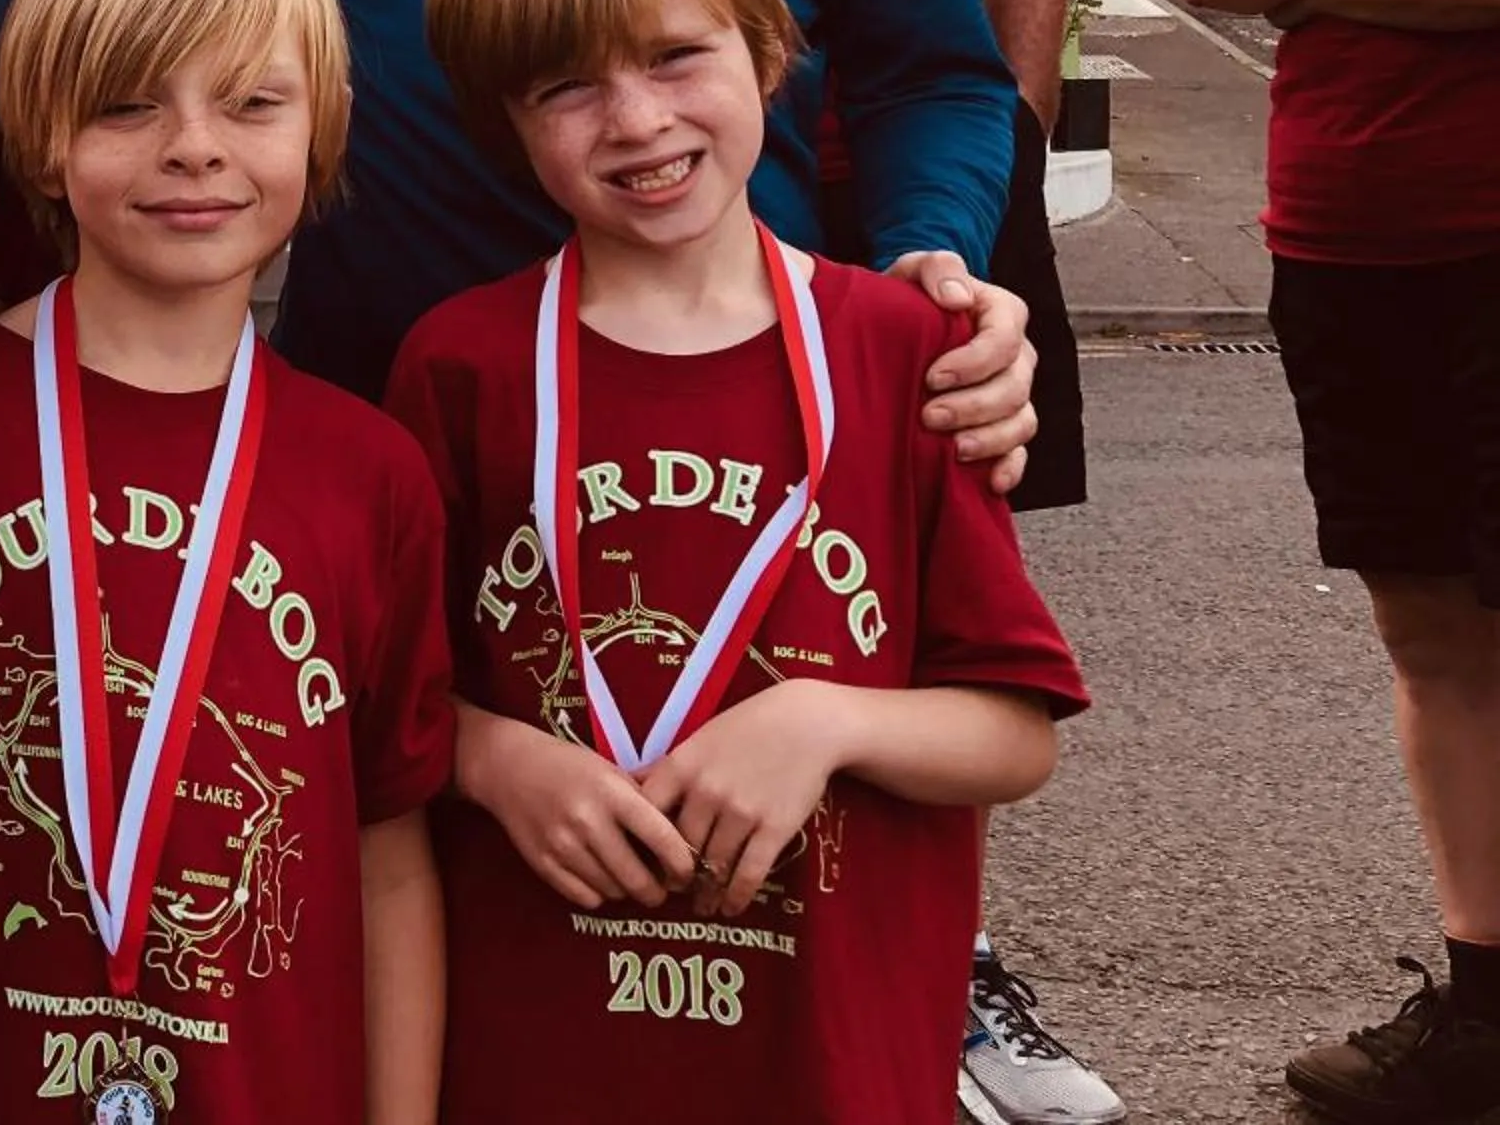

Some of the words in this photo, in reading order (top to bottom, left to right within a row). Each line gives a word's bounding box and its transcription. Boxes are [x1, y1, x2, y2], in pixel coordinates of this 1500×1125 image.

[647, 448, 764, 527] DE
[231, 539, 347, 729] BOG
[175, 779, 188, 798] &
[193, 782, 244, 810] LAKES
[571, 913, 797, 958] WWW.ROUNDSTONE.IE
[606, 950, 746, 1027] 2018
